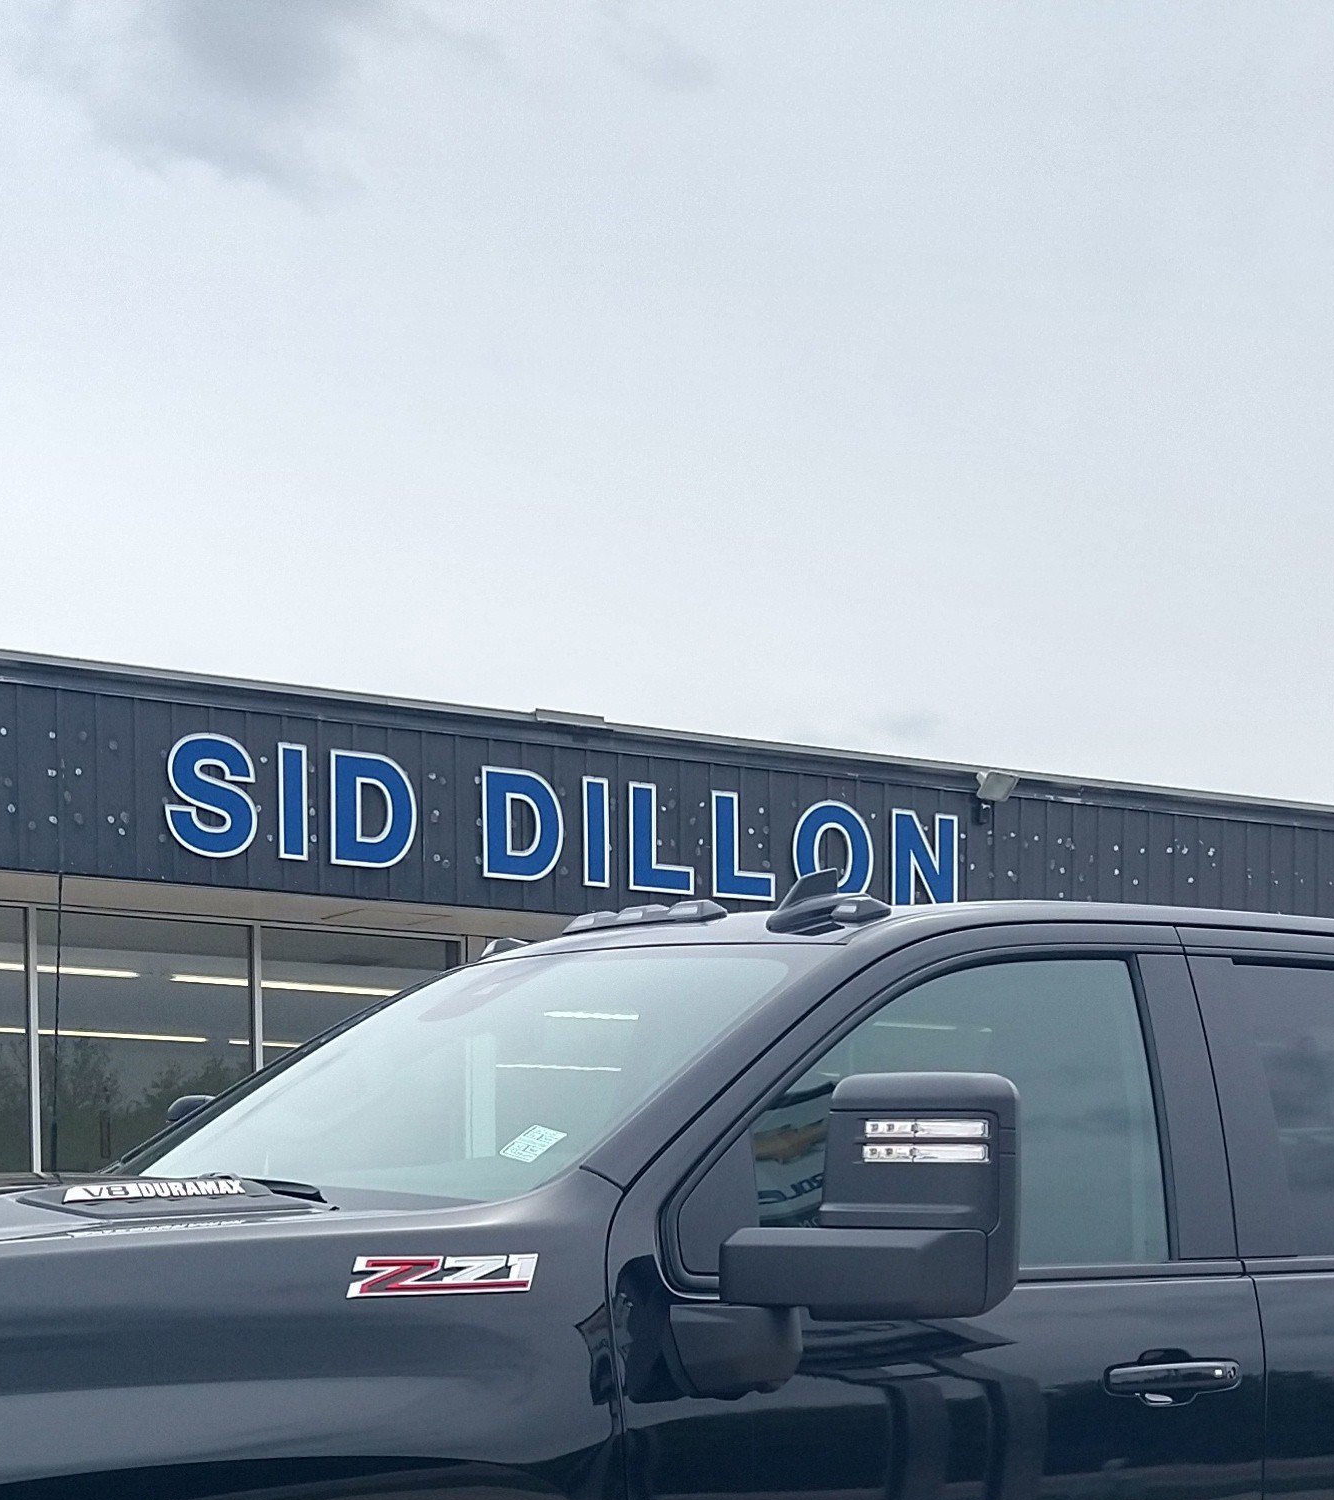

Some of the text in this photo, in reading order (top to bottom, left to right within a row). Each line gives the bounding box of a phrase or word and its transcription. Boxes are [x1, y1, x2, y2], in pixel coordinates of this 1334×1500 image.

[165, 732, 960, 906] SID DILLON
[139, 1180, 246, 1198] DURAMAX
[346, 1253, 539, 1298] Z71
